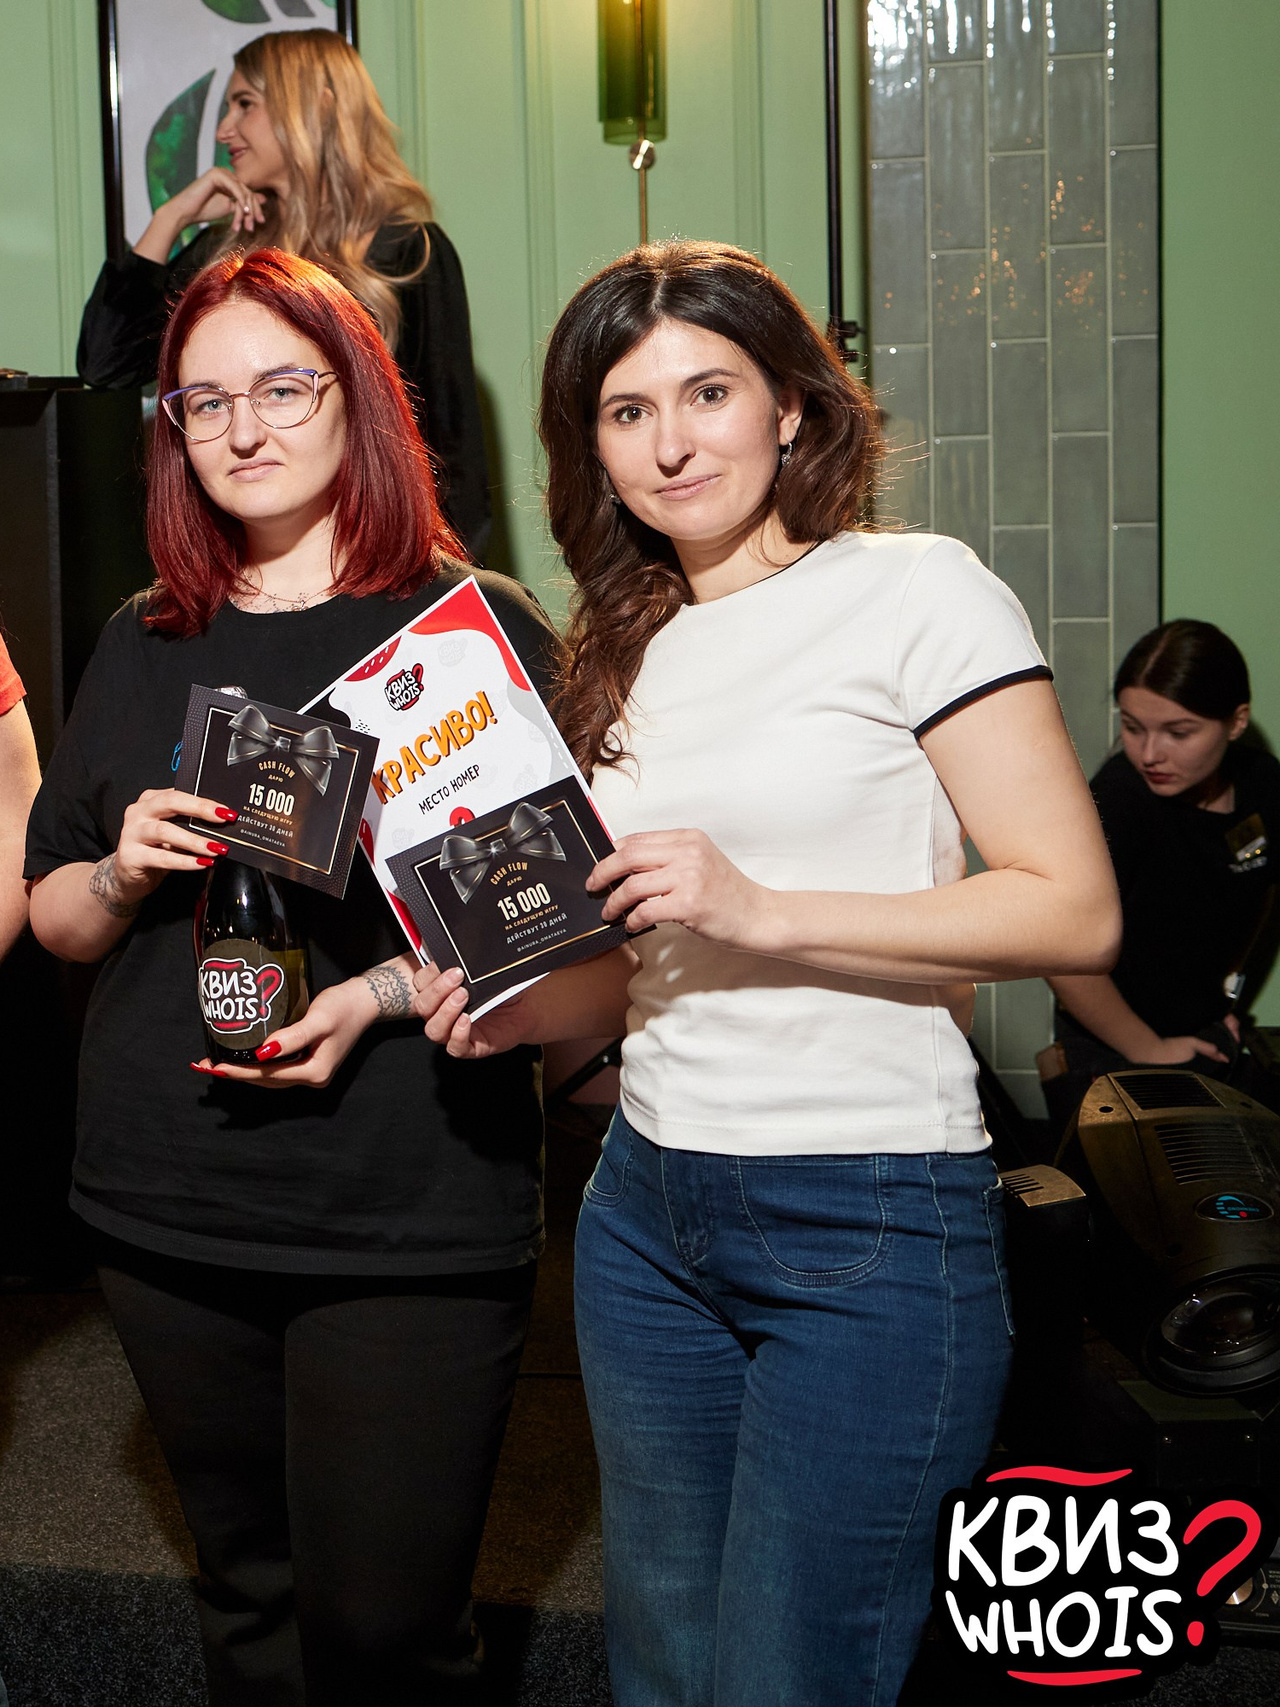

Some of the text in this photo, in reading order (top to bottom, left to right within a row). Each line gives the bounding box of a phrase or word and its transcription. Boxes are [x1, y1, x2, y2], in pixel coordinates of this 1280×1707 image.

[385, 672, 415, 701] КВИЗ
[371, 690, 498, 805] КРАСИВО!
[258, 760, 296, 779] CASH FLOW
[249, 783, 295, 816] 15 000
[418, 764, 480, 815] МЕСТО НОМЕР
[276, 828, 294, 838] ДНЕЙ
[490, 861, 528, 886] CASH FLOW
[497, 882, 551, 921] 15 000
[549, 912, 568, 927] ДНЕЙ
[201, 970, 257, 999] КВИЗ
